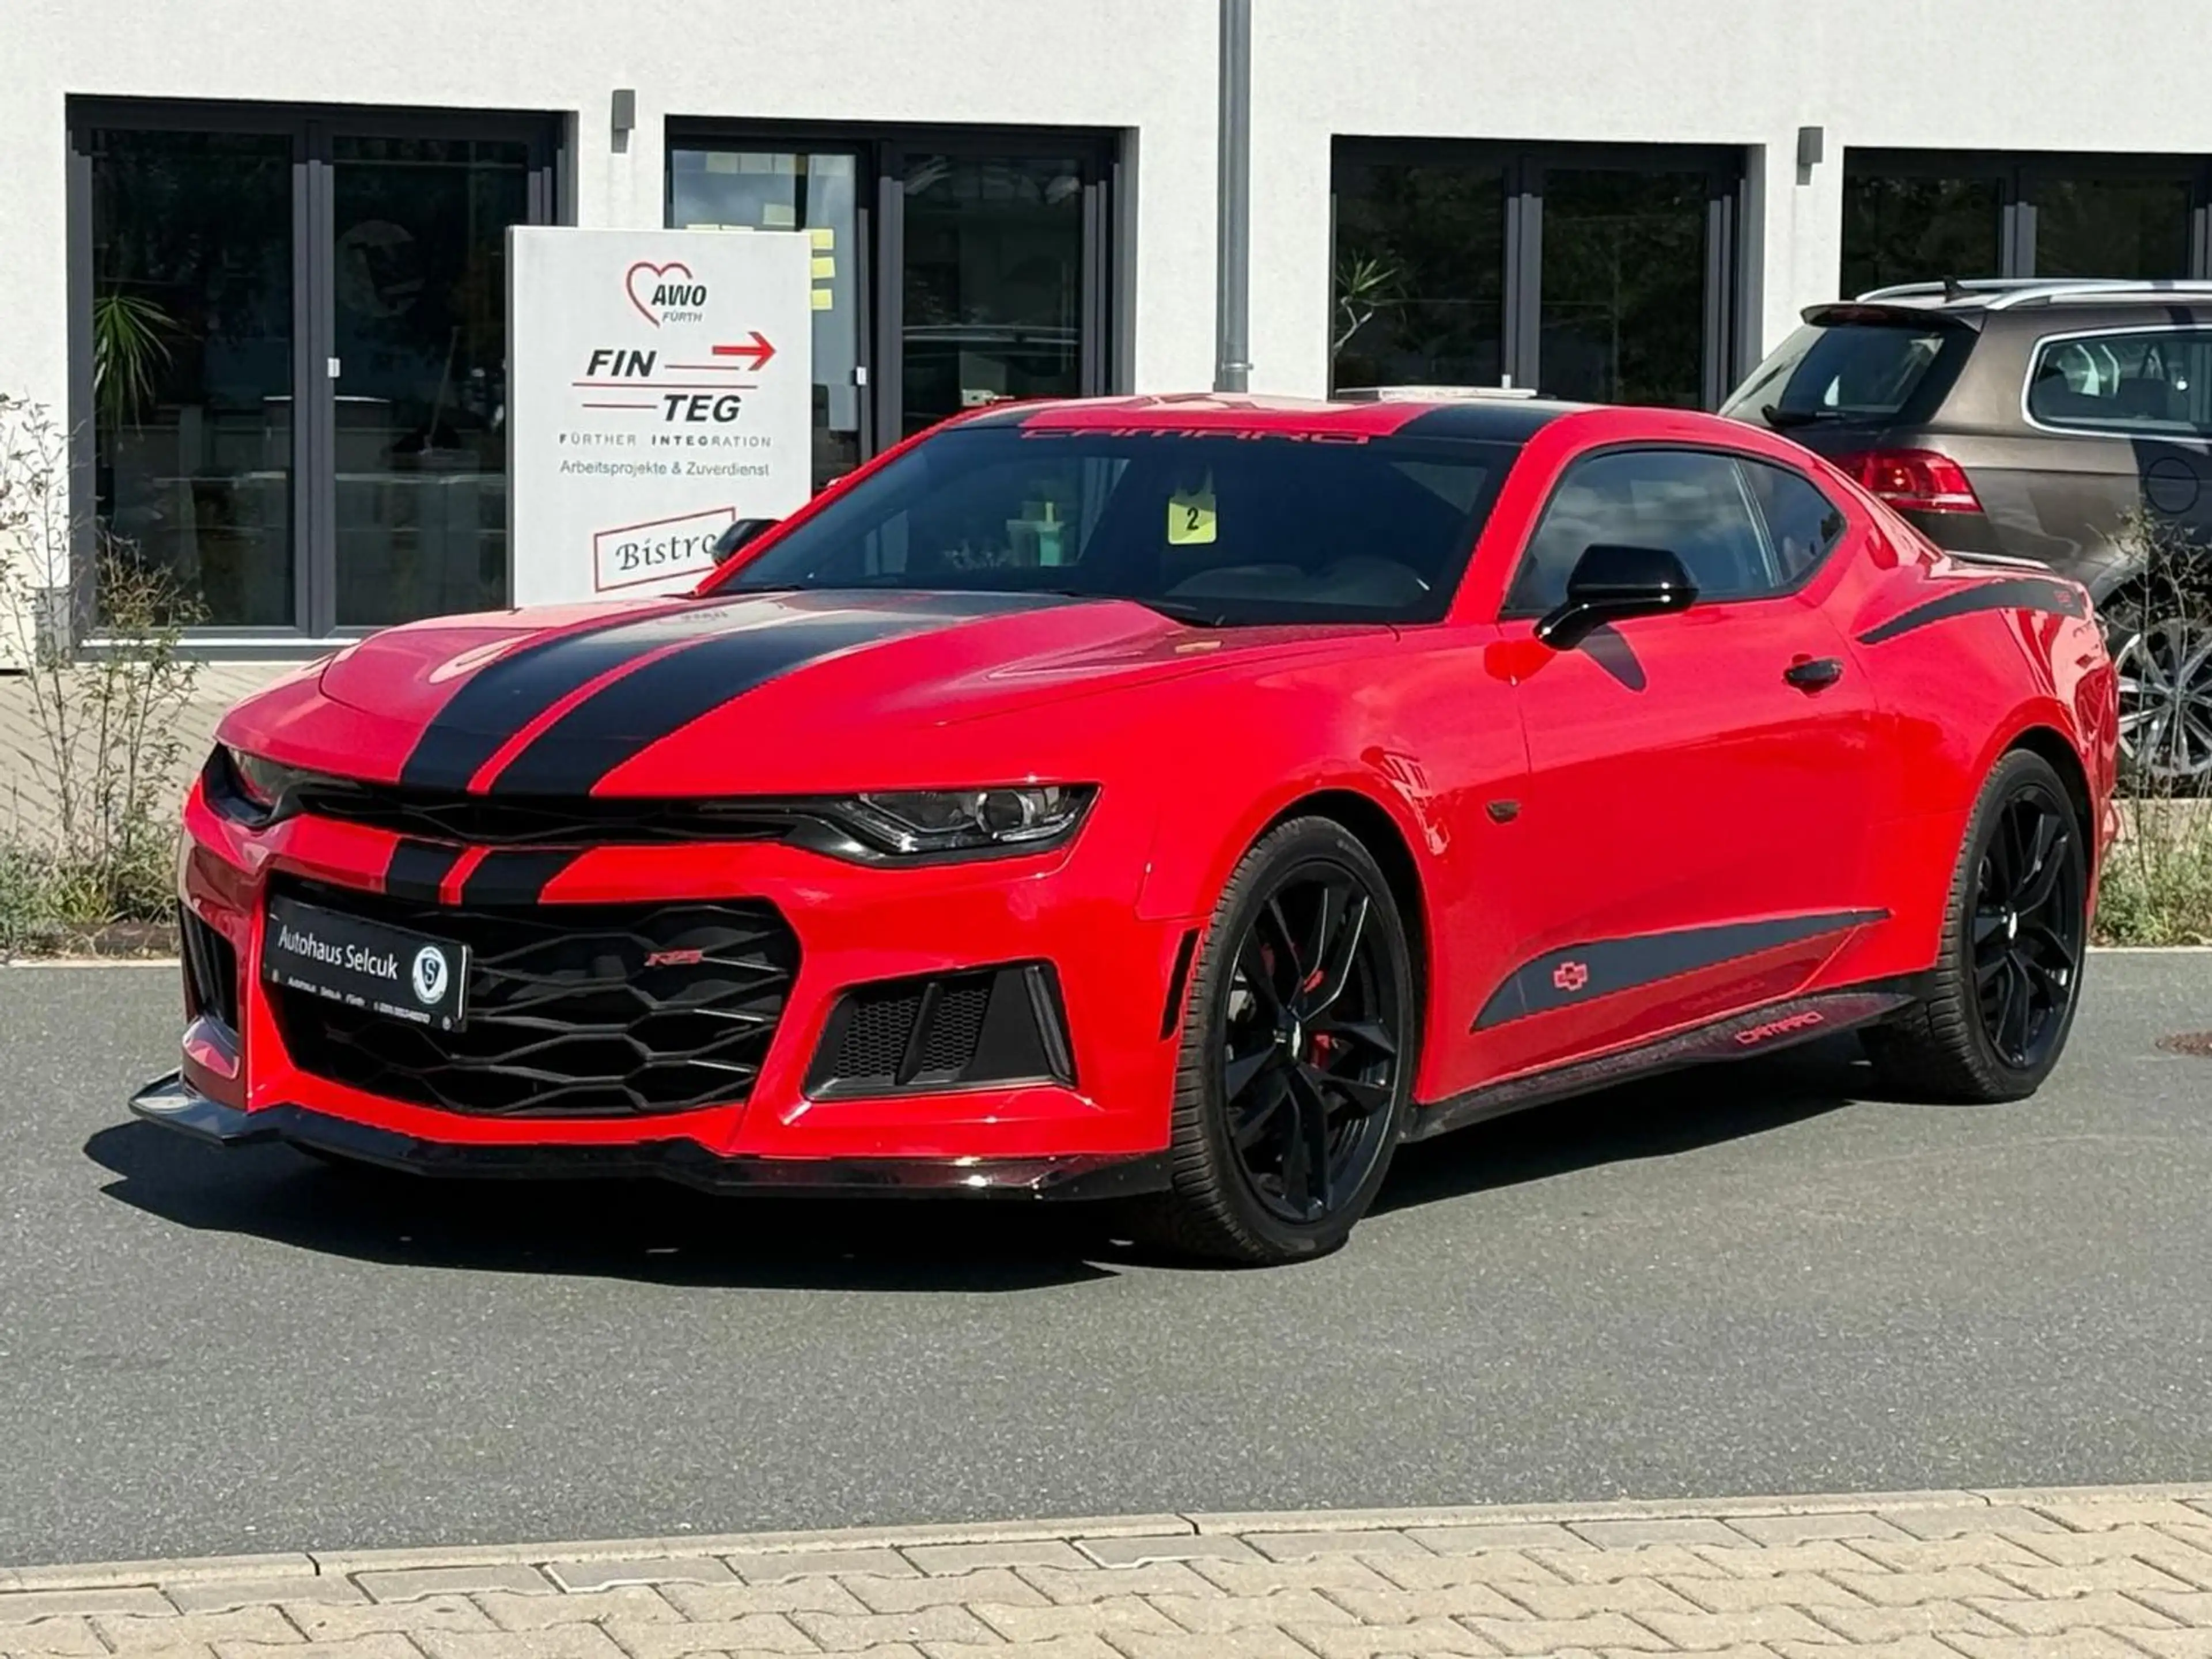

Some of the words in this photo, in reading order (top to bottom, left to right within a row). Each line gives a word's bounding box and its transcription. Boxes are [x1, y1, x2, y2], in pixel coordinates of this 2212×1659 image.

[652, 285, 707, 307] AWO
[661, 309, 703, 323] FÜRTH
[586, 349, 657, 377] FIN
[663, 394, 741, 422] TEG
[559, 431, 636, 446] FÜRTHER
[652, 434, 772, 448] INTEGRATION
[559, 460, 667, 478] Arbeitsprojekte
[671, 461, 682, 475] &
[685, 461, 770, 476] Zuverdienst
[1187, 507, 1199, 531] 2
[278, 925, 342, 965] Autohaus
[344, 944, 399, 980] Selcuk
